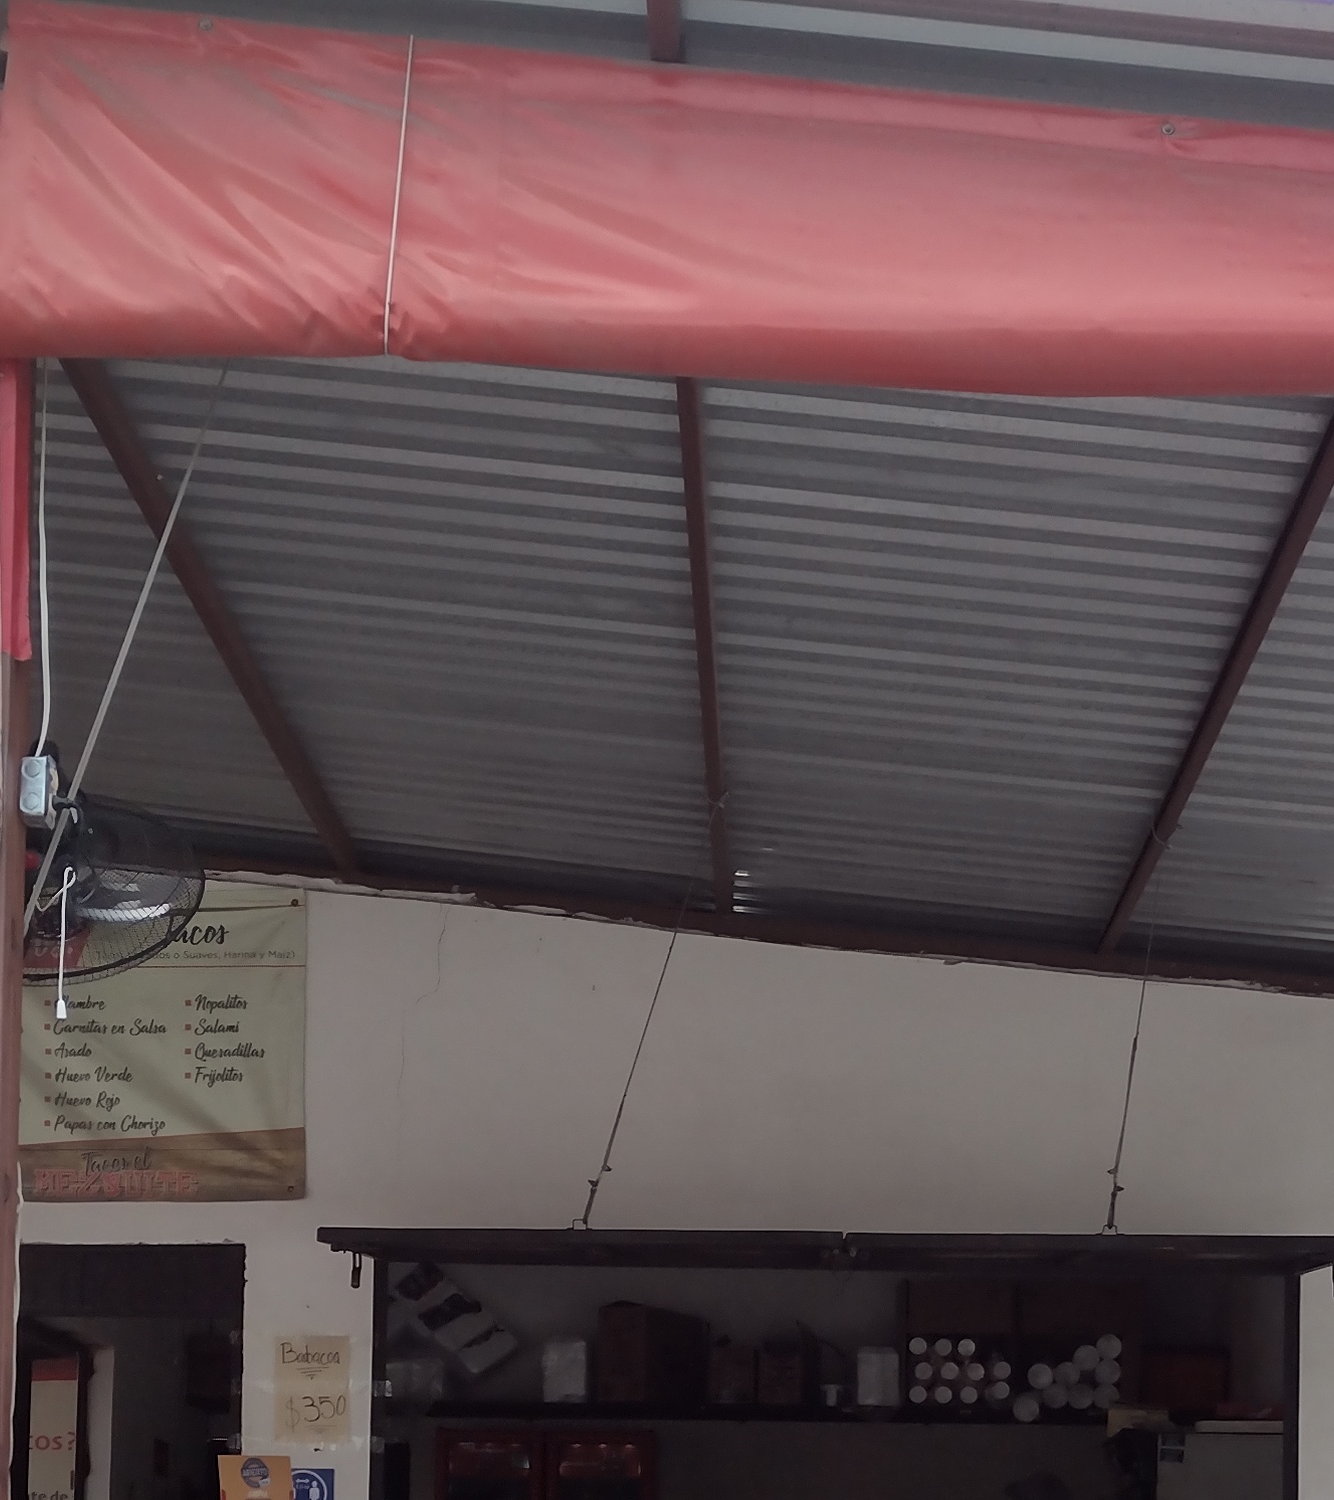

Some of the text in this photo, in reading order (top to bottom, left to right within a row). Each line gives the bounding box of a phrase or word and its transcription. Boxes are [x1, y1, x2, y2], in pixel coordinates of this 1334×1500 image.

[172, 925, 229, 945] acos
[195, 994, 248, 1014] Nopalitos
[53, 1018, 167, 1036] Carnitas en Salsa
[194, 1018, 240, 1036] Salami
[54, 1042, 92, 1058] Asado
[195, 1042, 265, 1062] Quesadillas
[55, 1066, 133, 1083] Huevo Verde
[195, 1067, 243, 1088] Frijolitos
[54, 1091, 120, 1112] Huevo Rojo
[54, 1115, 166, 1136] Papas con Chorizo
